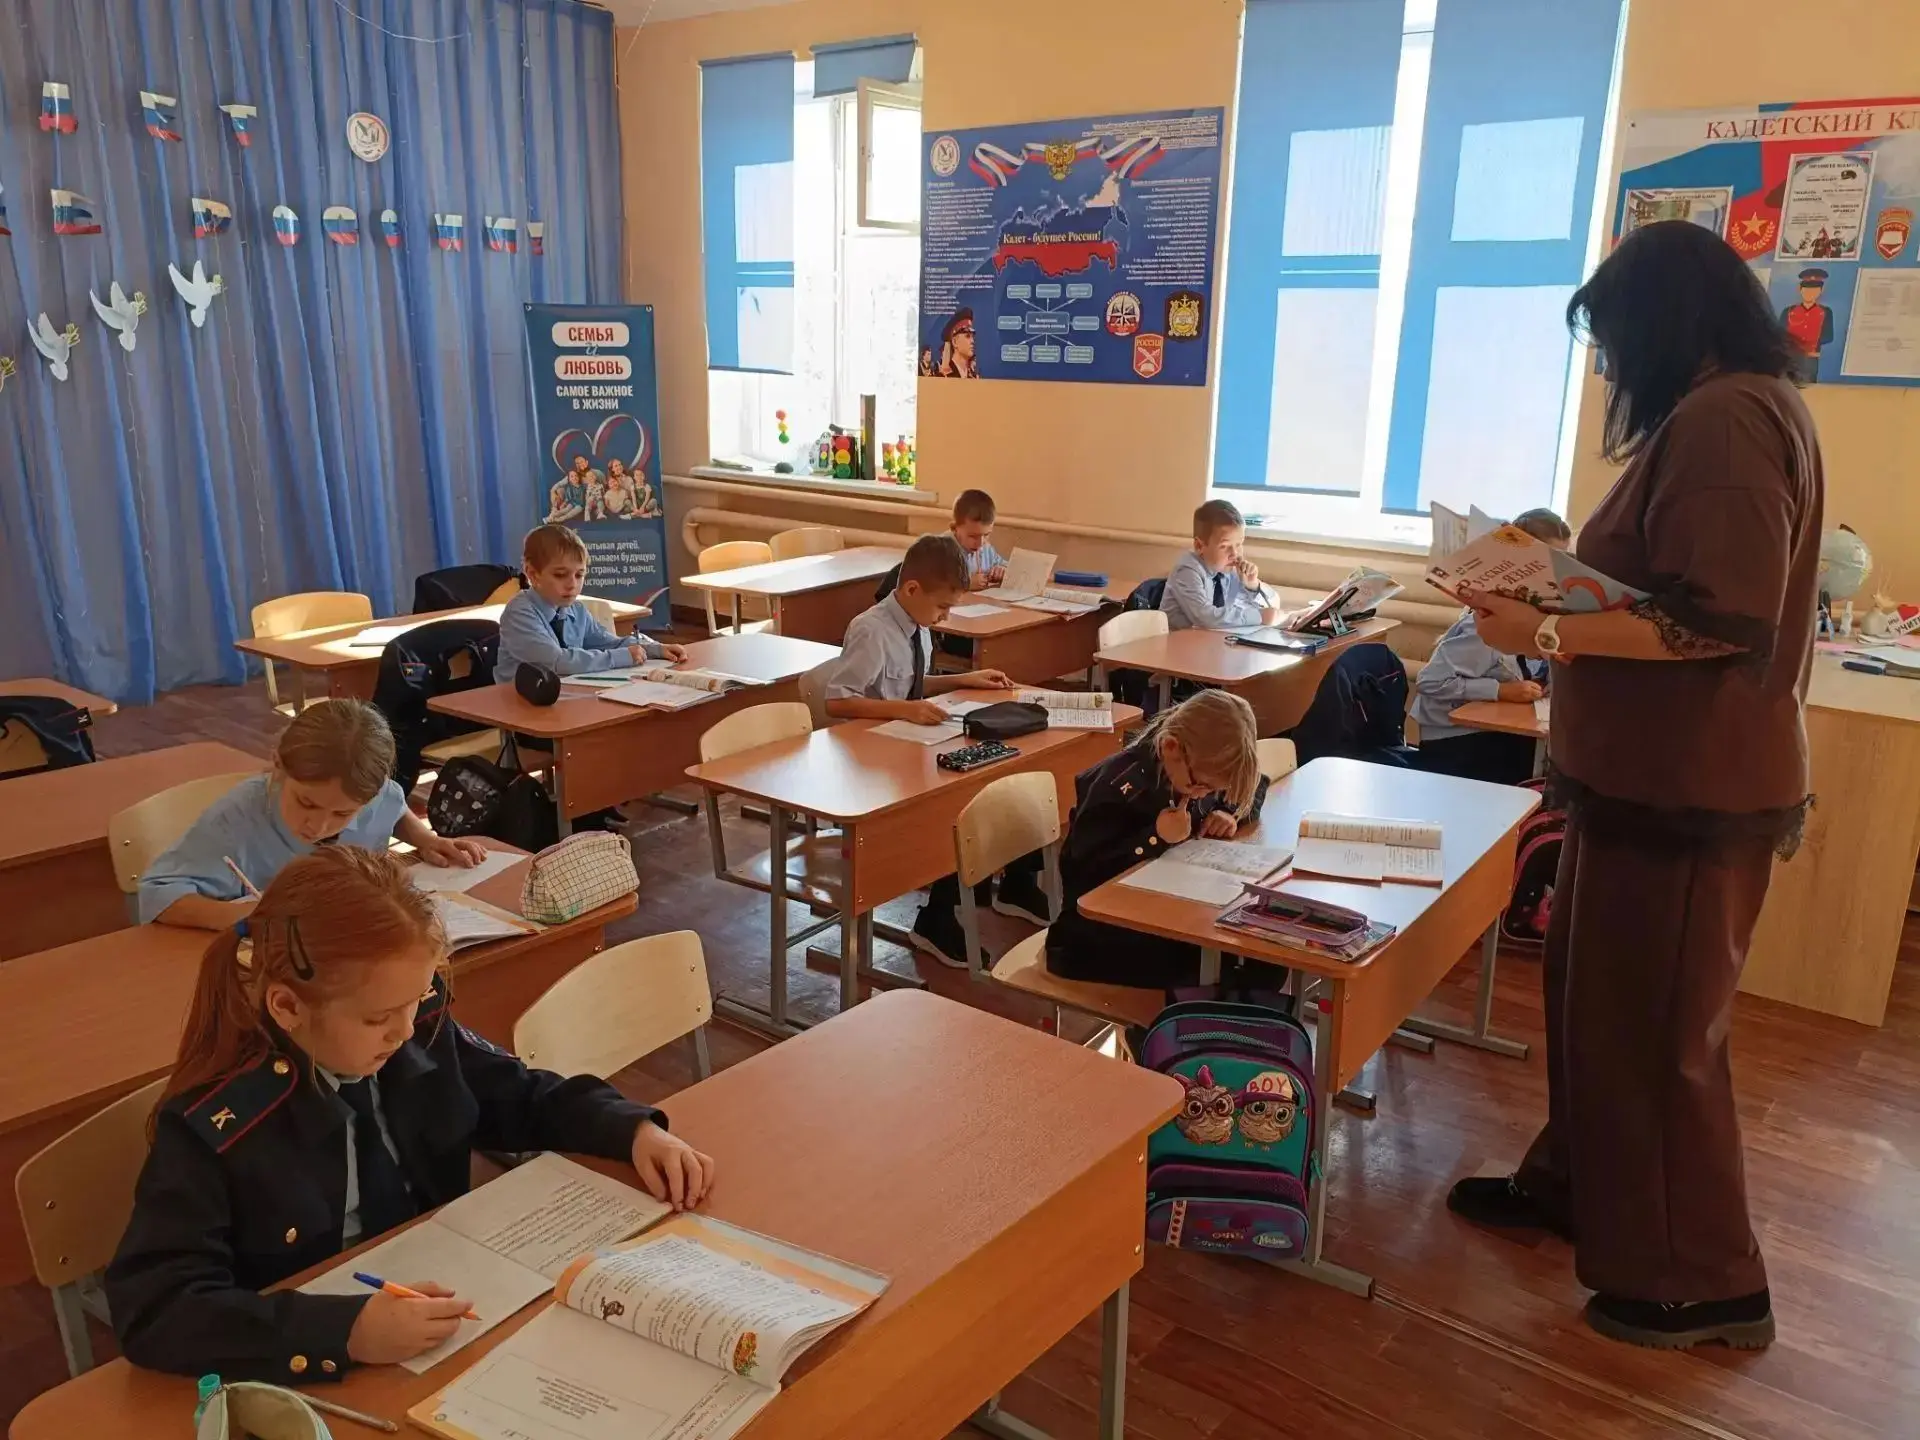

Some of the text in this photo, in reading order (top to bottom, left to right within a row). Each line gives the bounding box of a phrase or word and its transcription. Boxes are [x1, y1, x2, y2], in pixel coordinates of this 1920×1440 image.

[1706, 109, 1875, 139] КАДЕТСКИЙ
[1003, 232, 1026, 244] Кадет
[1033, 231, 1066, 248] будущее
[1068, 229, 1101, 242] России!
[568, 327, 614, 342] СЕМЬЯ
[564, 361, 624, 375] ЛЮБОВЬ
[556, 385, 634, 397] САМОЕ ВАЖНОЕ
[573, 398, 619, 410] В ЖИЗНИ
[589, 552, 656, 563] тываем будущую
[591, 566, 621, 575] страны,
[1895, 614, 1920, 635] УЧИТ
[1250, 1076, 1288, 1093] BOY
[210, 1106, 236, 1131] К
